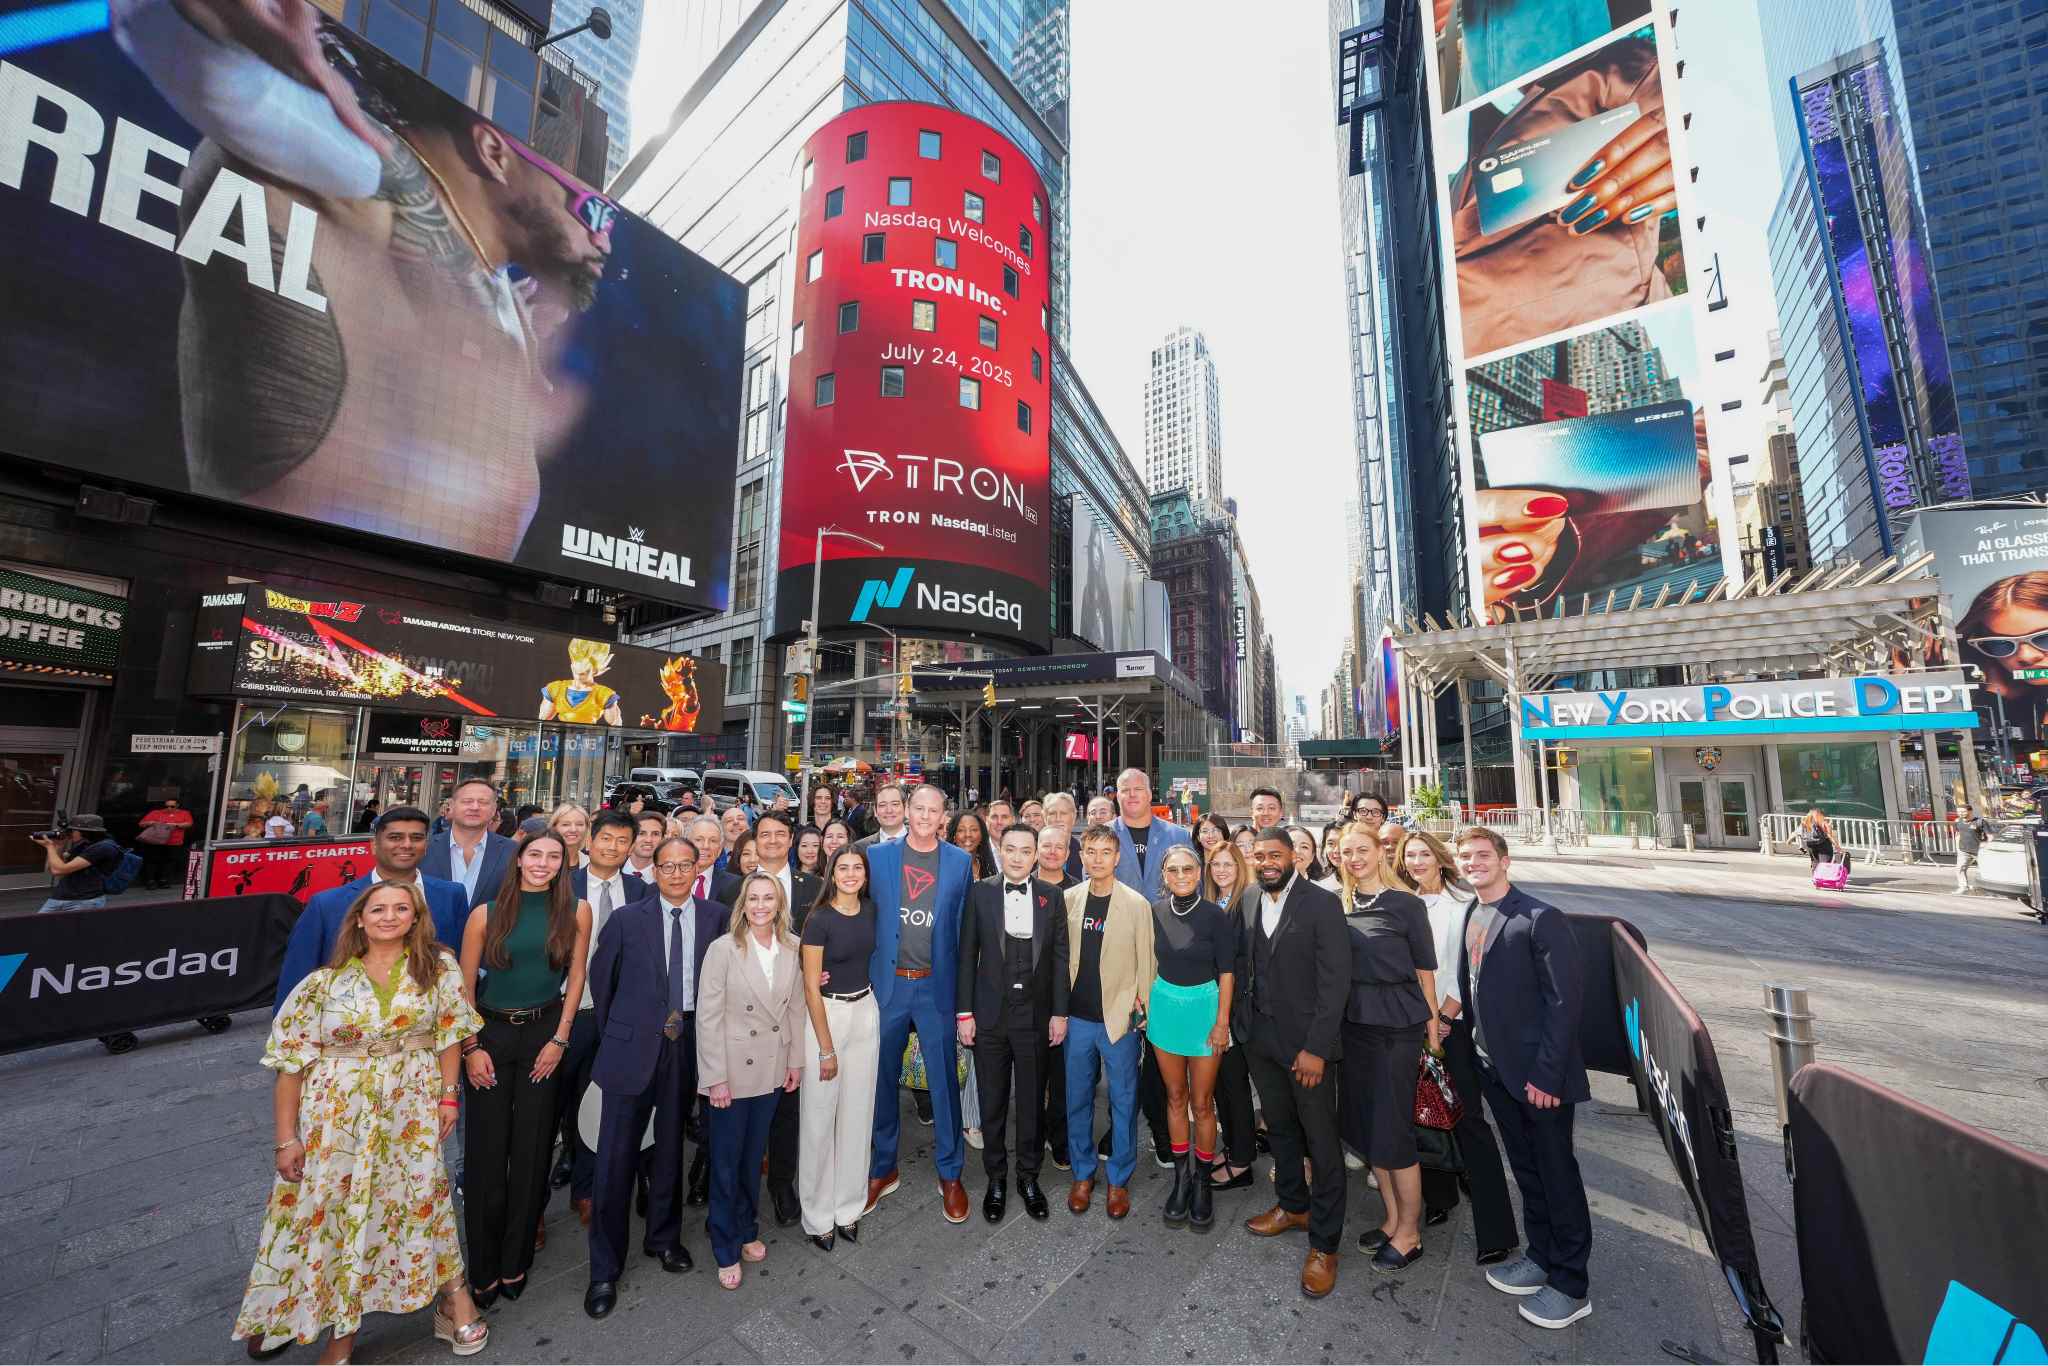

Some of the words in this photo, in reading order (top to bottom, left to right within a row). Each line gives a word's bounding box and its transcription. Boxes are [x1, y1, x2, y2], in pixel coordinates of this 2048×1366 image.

[0, 58, 329, 313] REAL
[864, 210, 941, 233] Nasdaq
[948, 217, 1031, 275] Welcomes
[891, 268, 964, 297] TRON
[969, 283, 1008, 316] Inc.
[881, 343, 924, 365] July
[932, 348, 963, 372] 24,
[970, 356, 1013, 388] 2025
[897, 454, 1024, 516] TRON
[866, 510, 920, 524] TRON
[561, 523, 696, 587] UNREAL
[1960, 551, 1996, 566] THAT
[1998, 545, 2048, 561] TRANS
[1977, 539, 1992, 551] AI
[917, 582, 1022, 631] Nasdaq
[402, 616, 438, 629] TAMASHII
[472, 627, 496, 638] STORE
[497, 633, 515, 641] NEW
[515, 634, 535, 644] YORK
[2025, 670, 2035, 679] W
[380, 737, 418, 746] TAMASHII
[226, 852, 262, 865] OFF.
[266, 850, 303, 862] THE.
[306, 846, 369, 859] CHARTS.
[30, 947, 239, 999] Nasdaq
